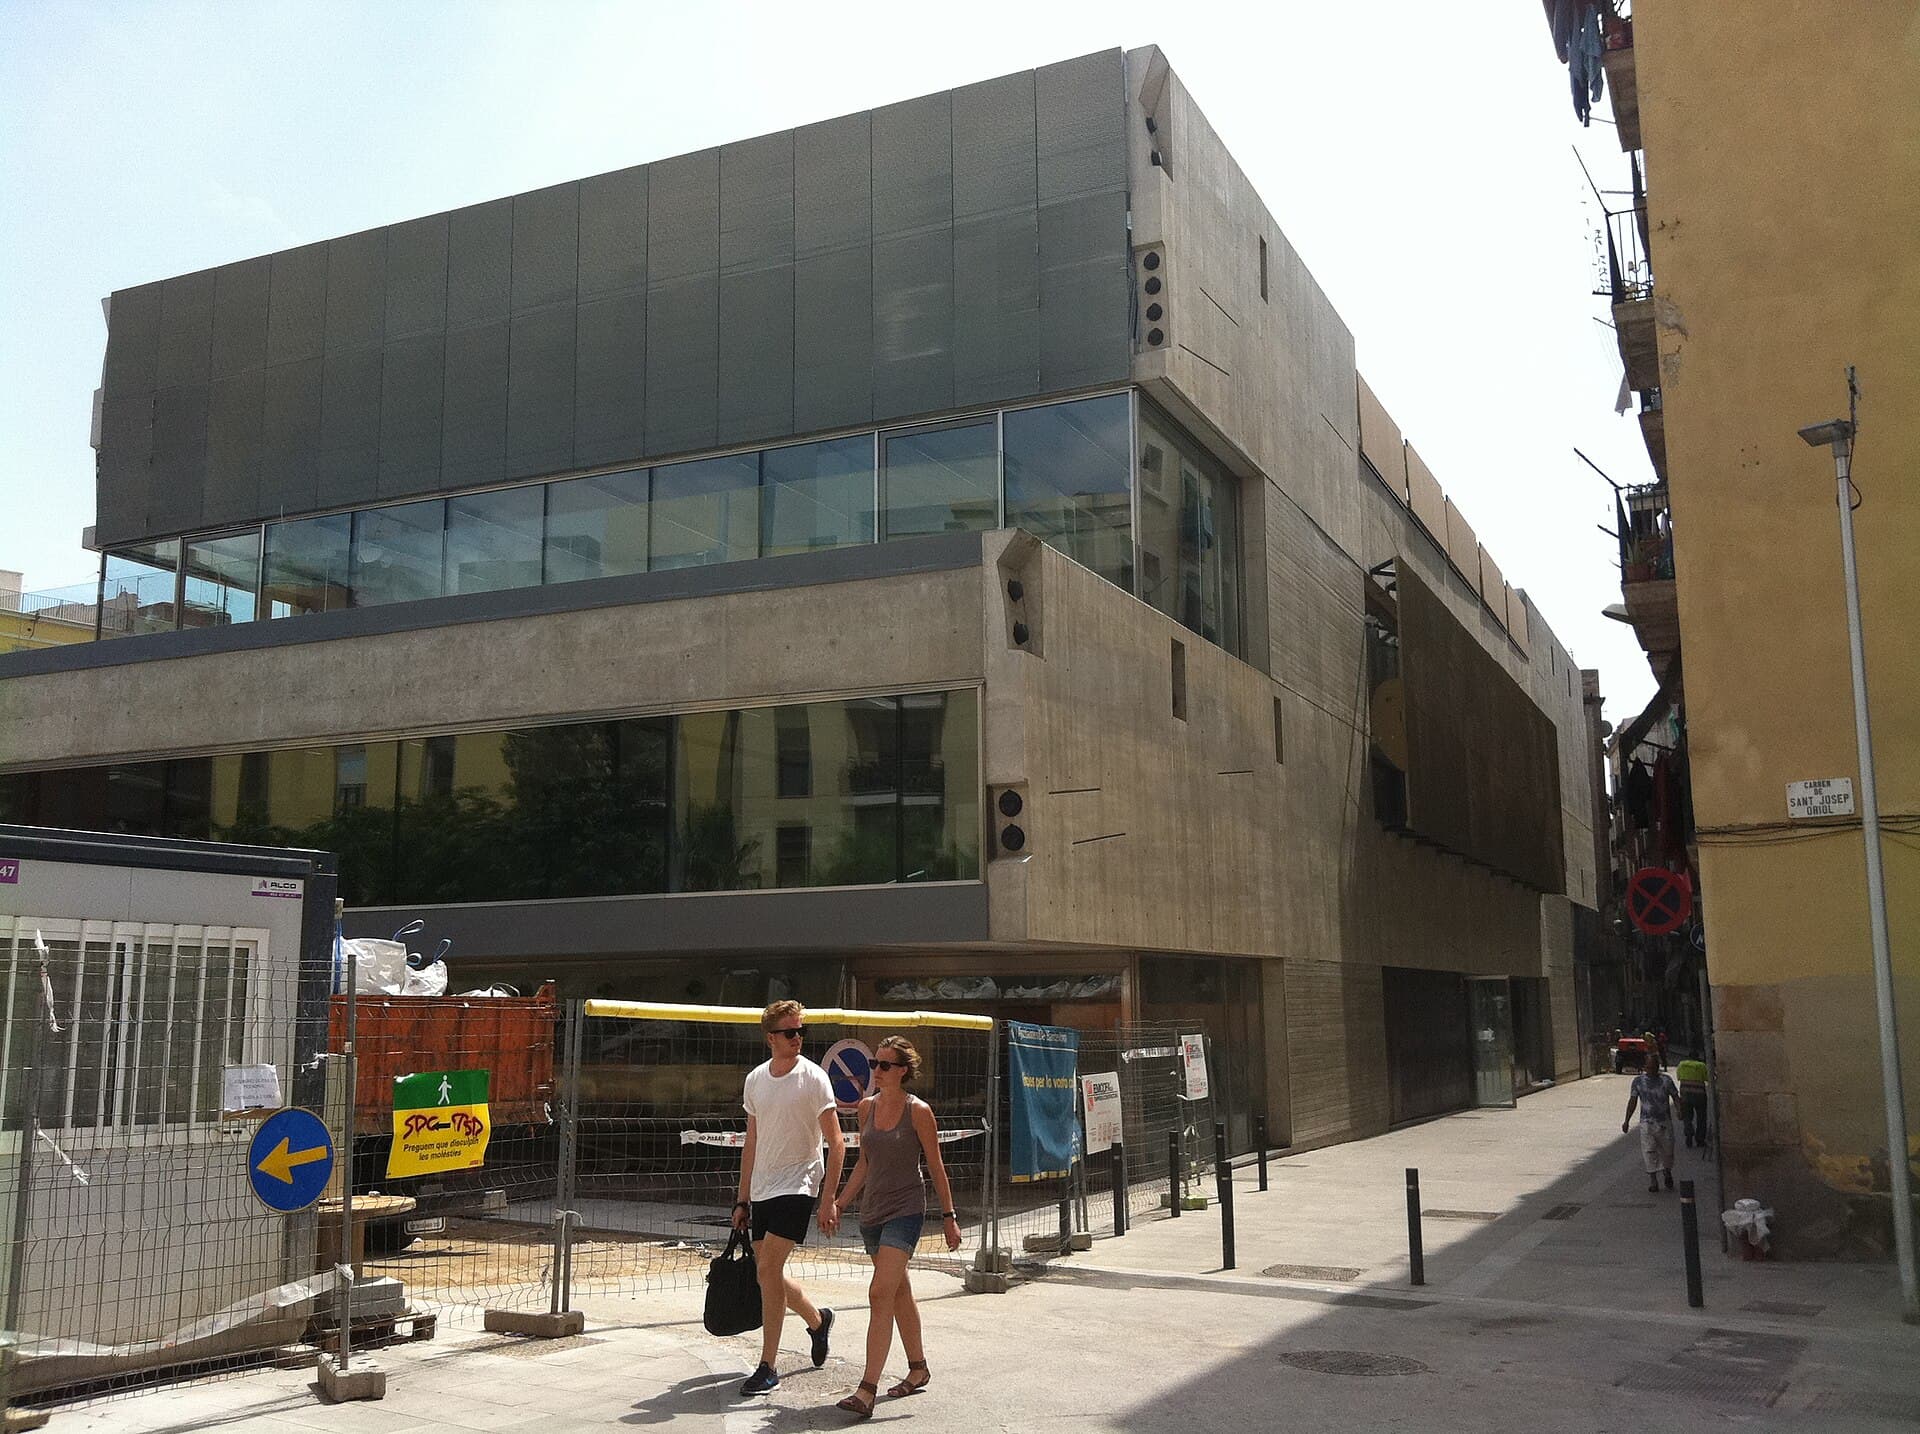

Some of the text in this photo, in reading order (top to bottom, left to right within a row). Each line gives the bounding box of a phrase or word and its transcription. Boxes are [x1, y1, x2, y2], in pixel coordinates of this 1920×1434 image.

[1814, 788, 1824, 796] DE
[1790, 793, 1849, 808] SANT JOSEP
[1806, 805, 1834, 816] ORIOL
[403, 1143, 435, 1153] Preguem
[435, 1141, 449, 1150] que
